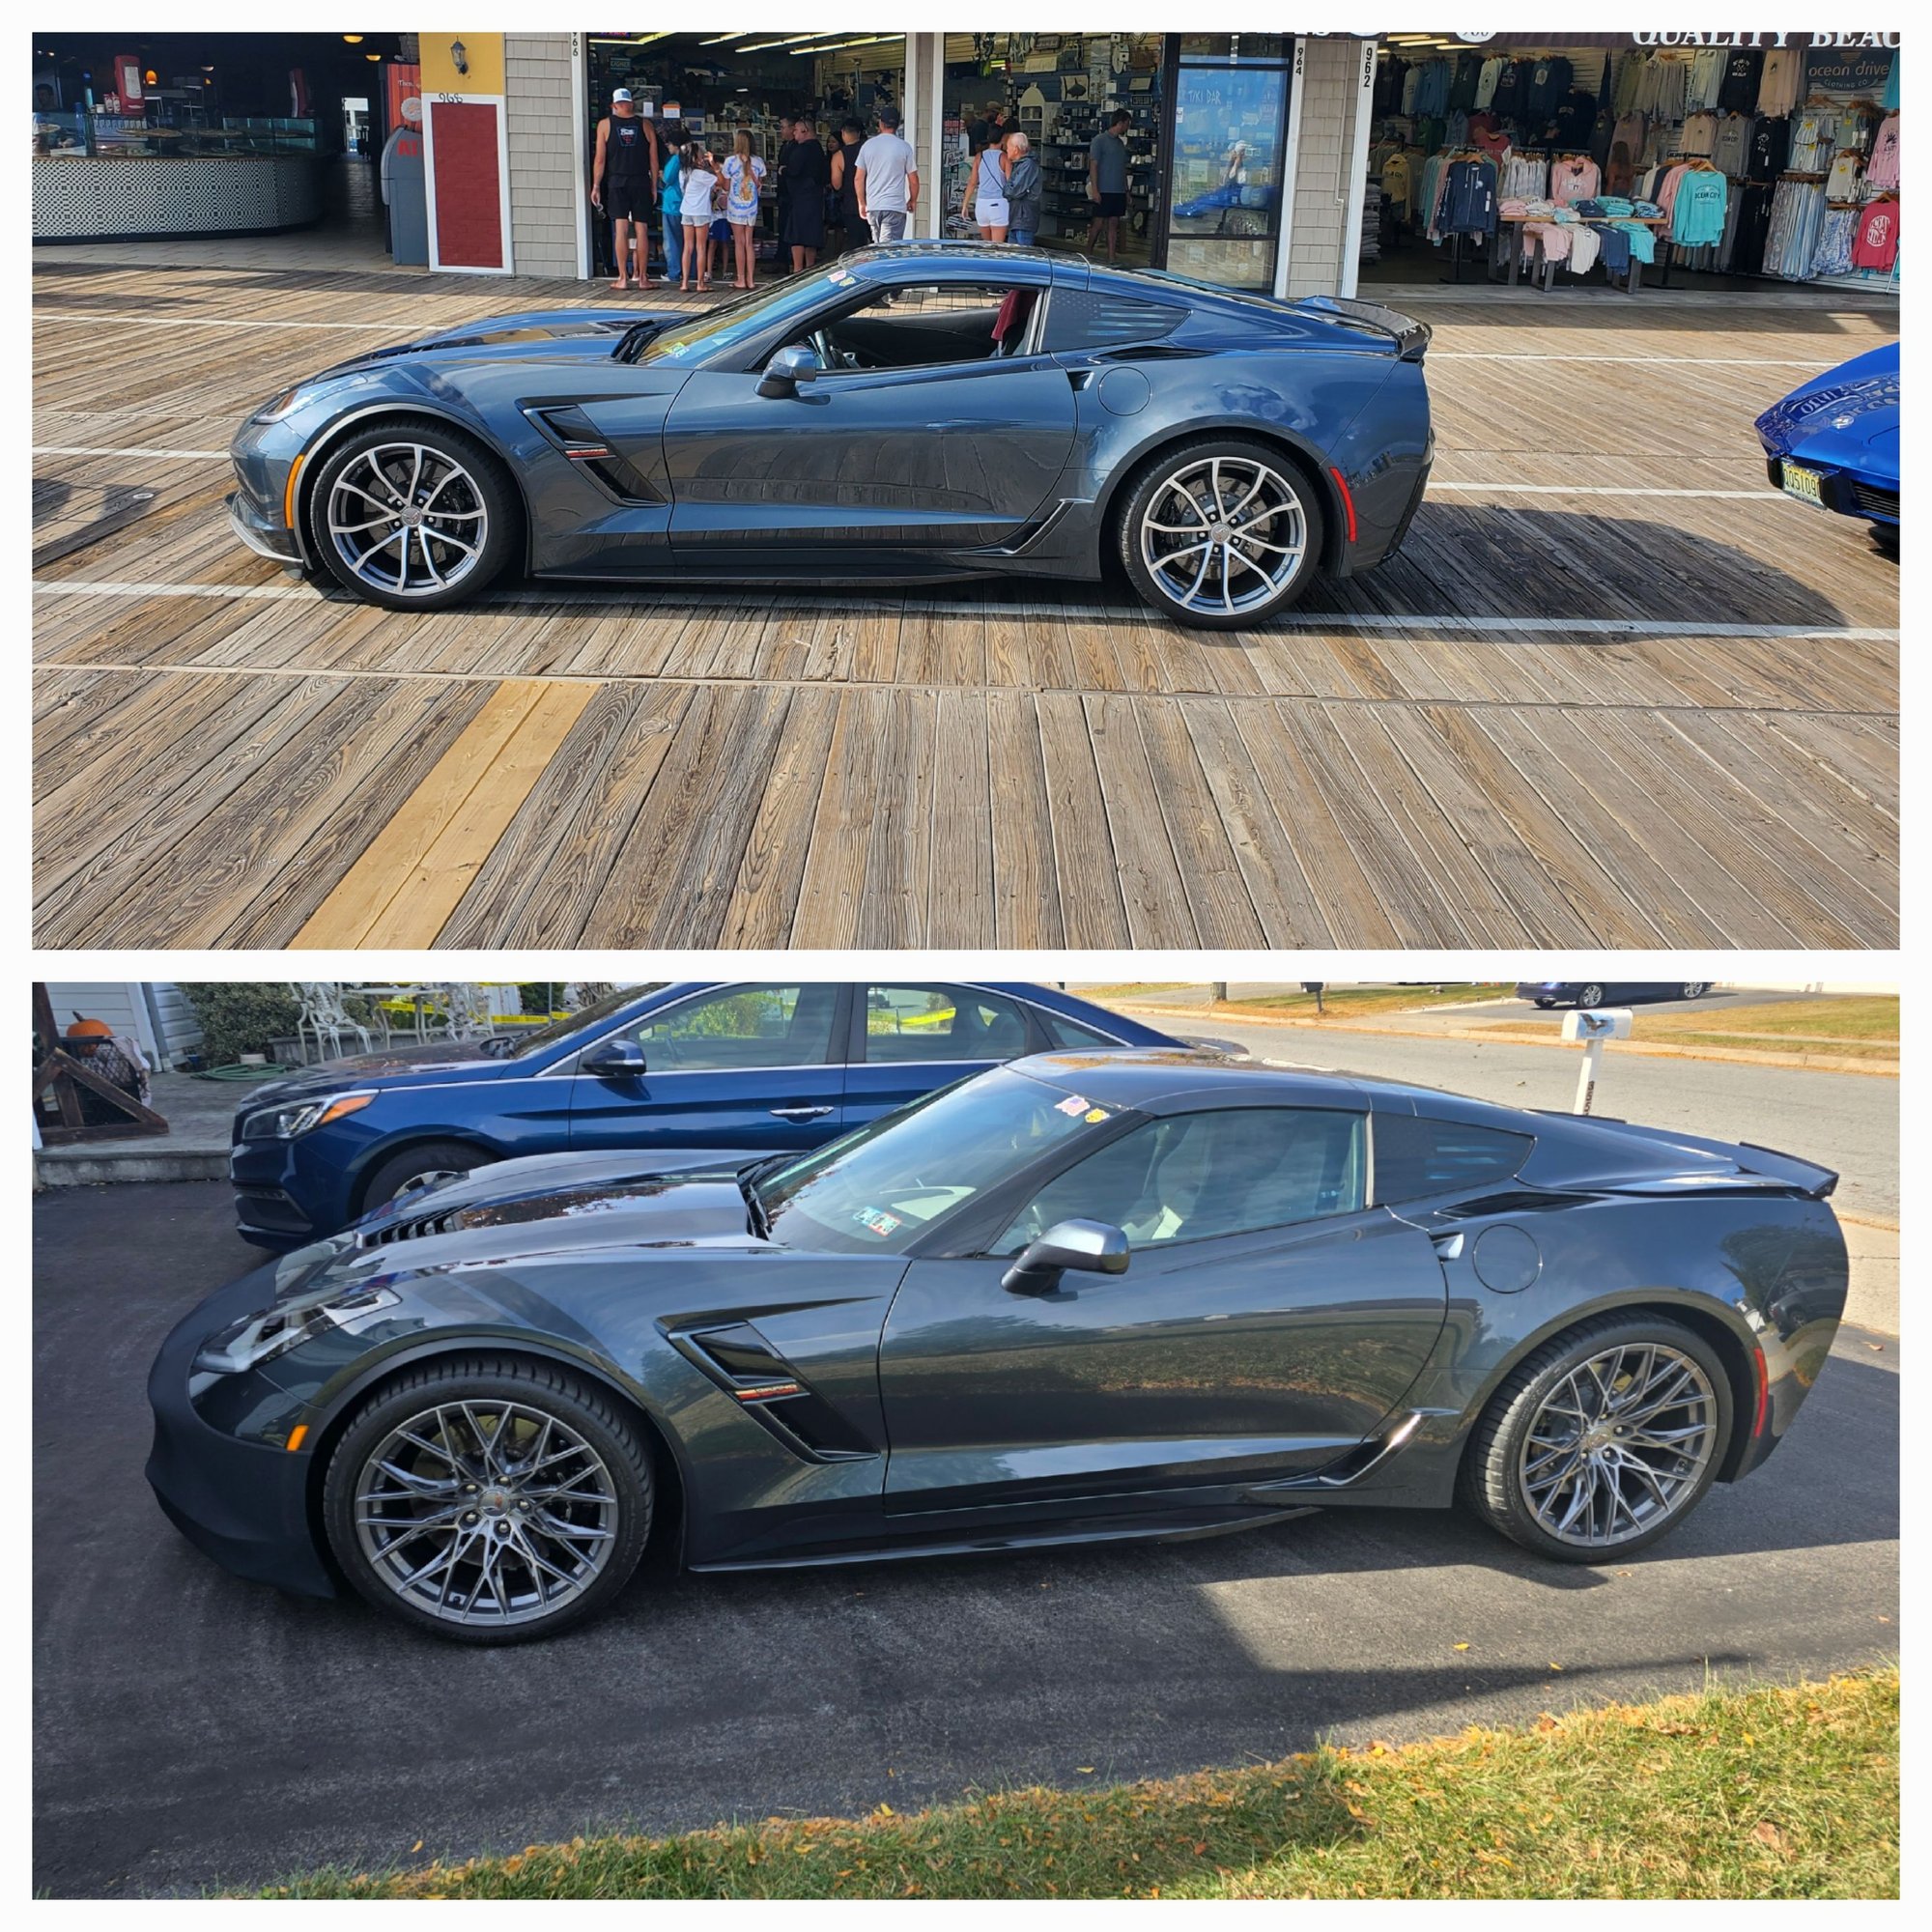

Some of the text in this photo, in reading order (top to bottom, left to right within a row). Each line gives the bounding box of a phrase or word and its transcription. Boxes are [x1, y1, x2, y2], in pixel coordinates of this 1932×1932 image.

[1295, 47, 1304, 75] 964
[1363, 47, 1373, 88] 962
[1808, 60, 1889, 76] ocean drive
[1824, 79, 1855, 88] CLOTHING
[439, 92, 463, 103] 968
